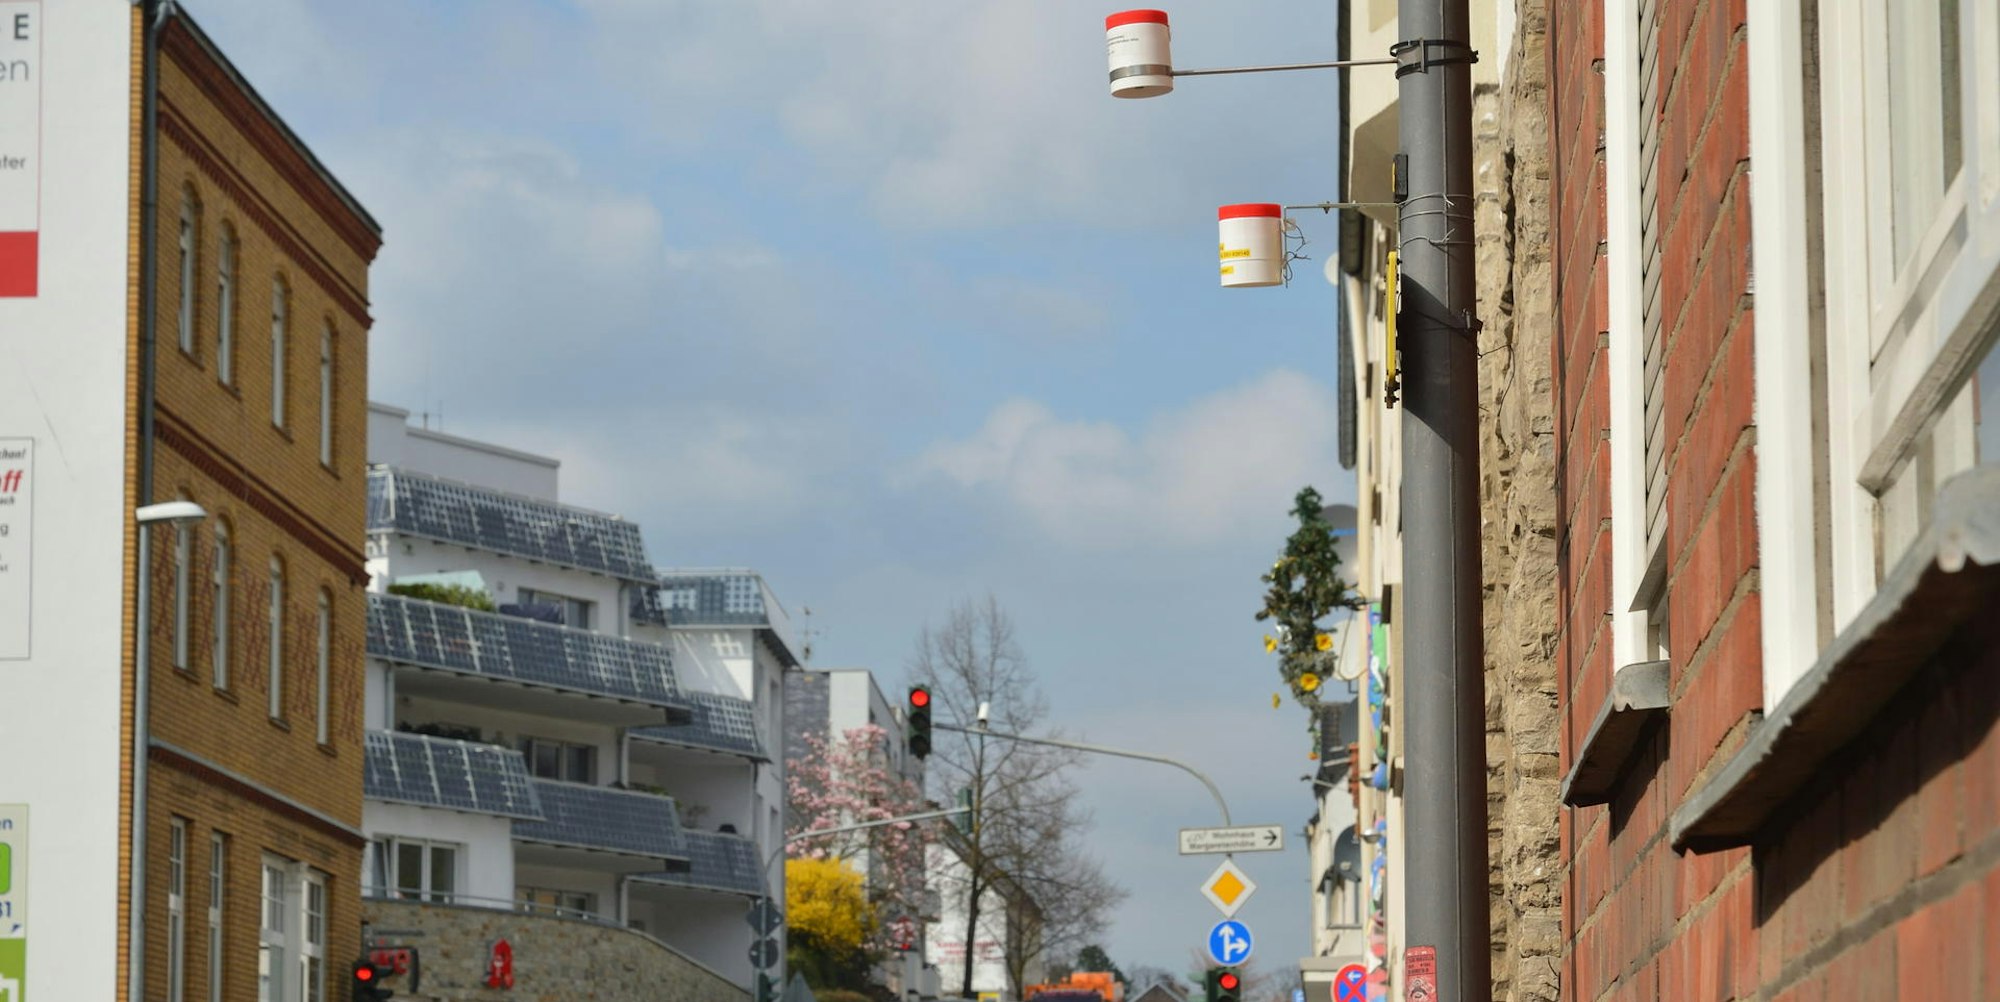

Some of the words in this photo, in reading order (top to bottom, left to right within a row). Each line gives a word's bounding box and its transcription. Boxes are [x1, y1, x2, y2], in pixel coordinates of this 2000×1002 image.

[13, 14, 29, 40] E
[0, 153, 26, 170] ter
[0, 468, 24, 493] ff
[0, 818, 13, 830] n
